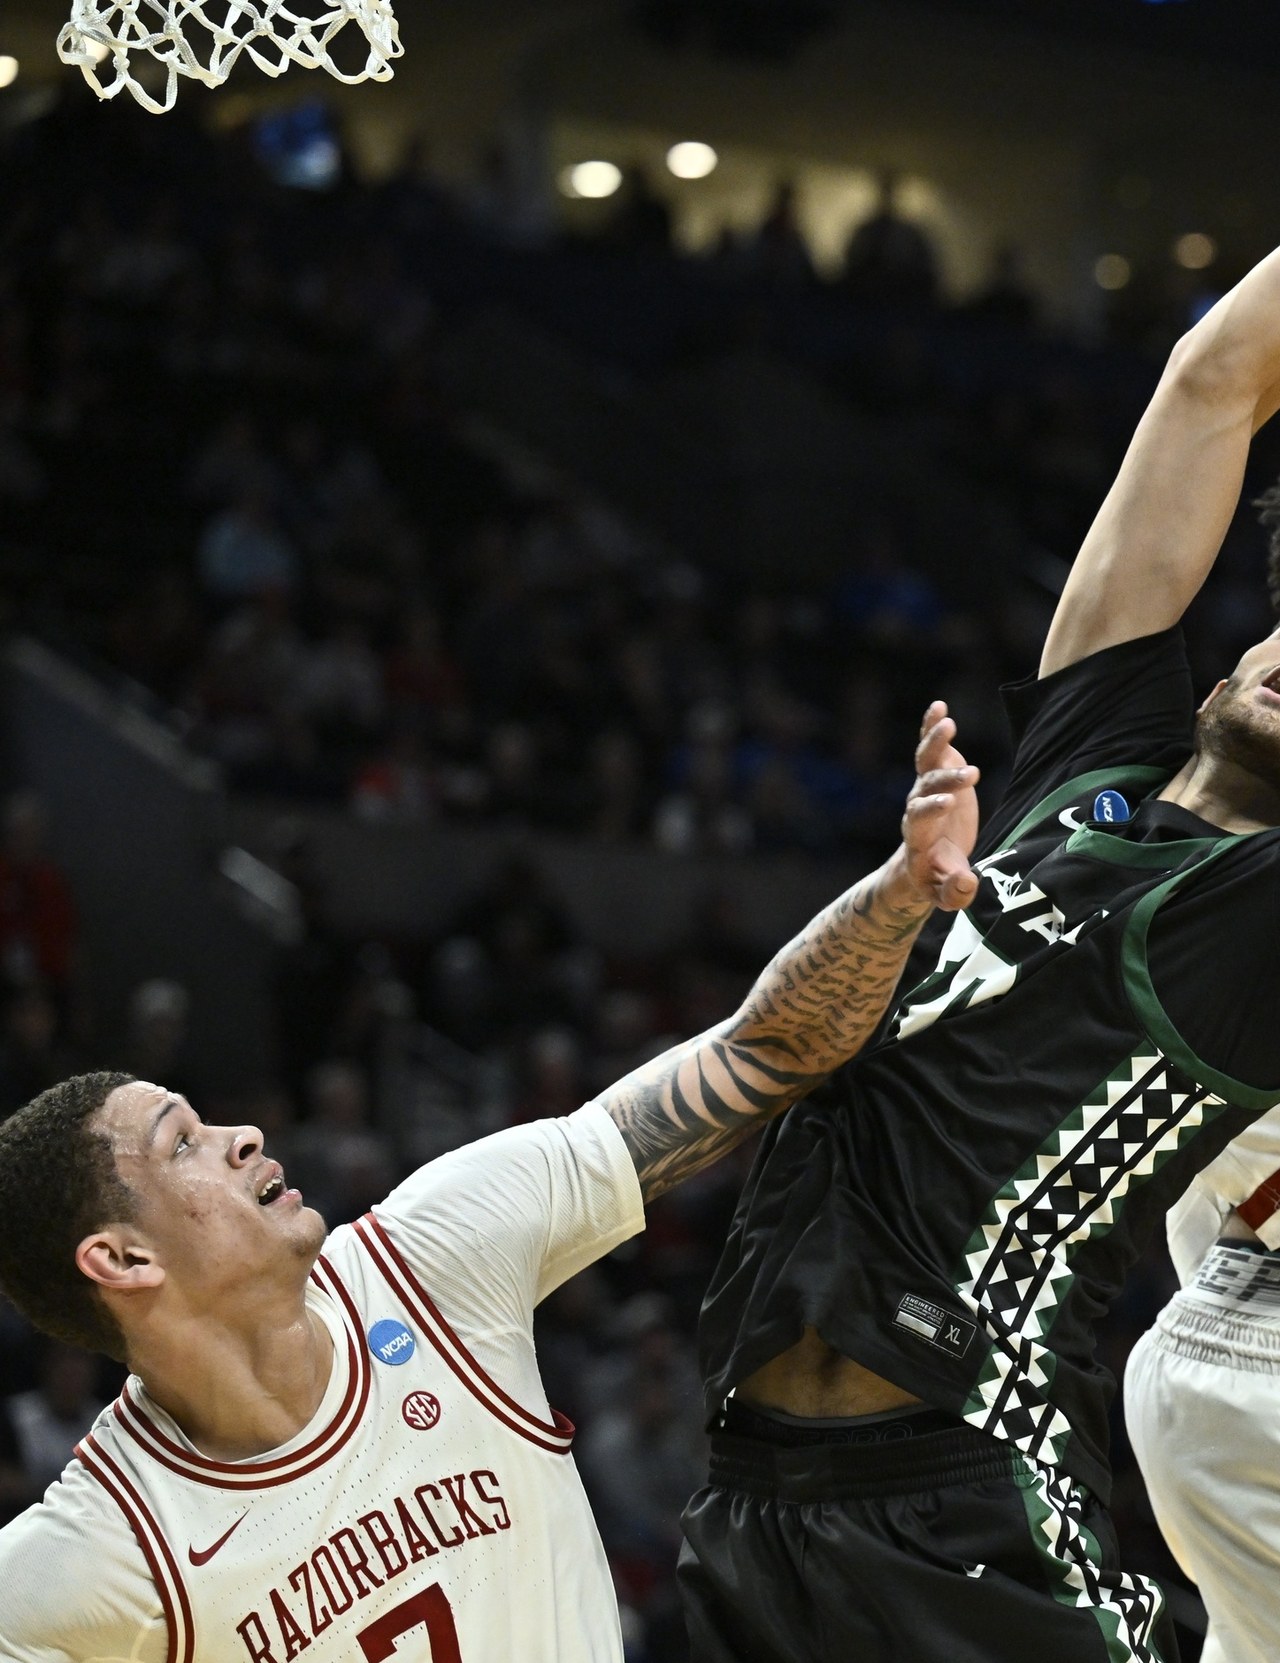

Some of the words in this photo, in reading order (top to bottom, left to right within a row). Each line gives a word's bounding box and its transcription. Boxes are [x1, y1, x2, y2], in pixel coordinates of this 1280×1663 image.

[905, 1296, 945, 1318] ENGINEERED
[379, 1331, 413, 1360] NCAA
[944, 1324, 961, 1346] XL
[405, 1393, 438, 1428] SEC
[235, 1469, 512, 1663] RAZORBACKS
[355, 1581, 463, 1663] 7
